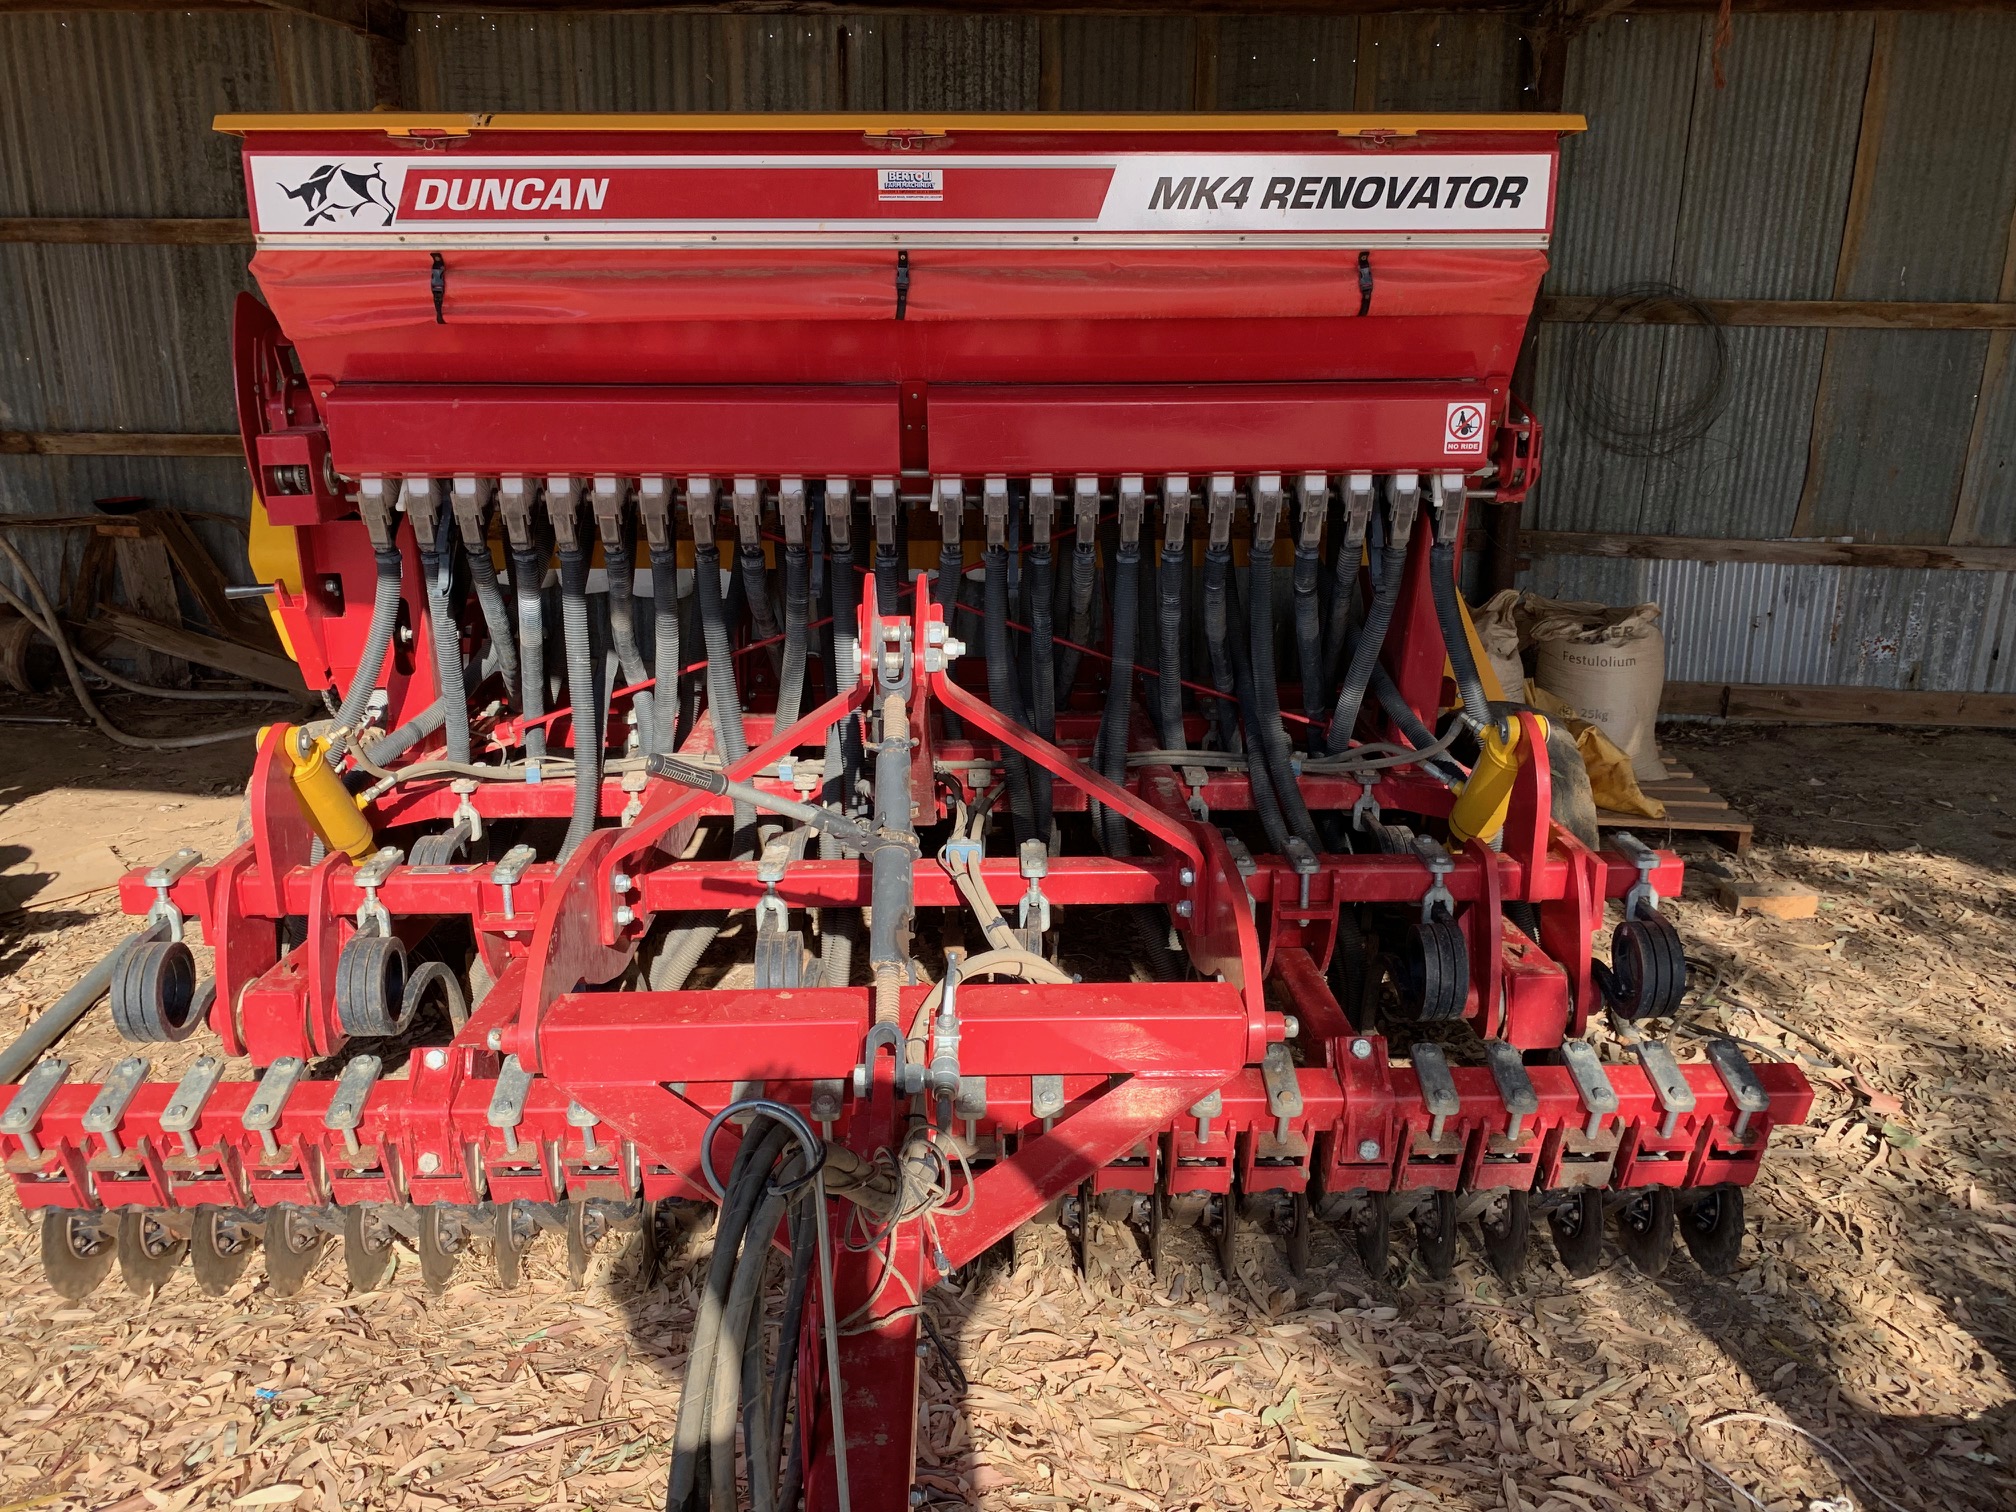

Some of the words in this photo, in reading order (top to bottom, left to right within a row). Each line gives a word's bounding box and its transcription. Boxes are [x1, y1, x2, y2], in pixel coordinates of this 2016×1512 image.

[887, 171, 932, 183] BERTOLI
[414, 177, 610, 212] DUNCAN
[1148, 176, 1254, 210] MK4
[1260, 175, 1529, 210] RENOVATOR
[1562, 650, 1636, 667] Festulolium
[1580, 708, 1609, 722] 25kg
